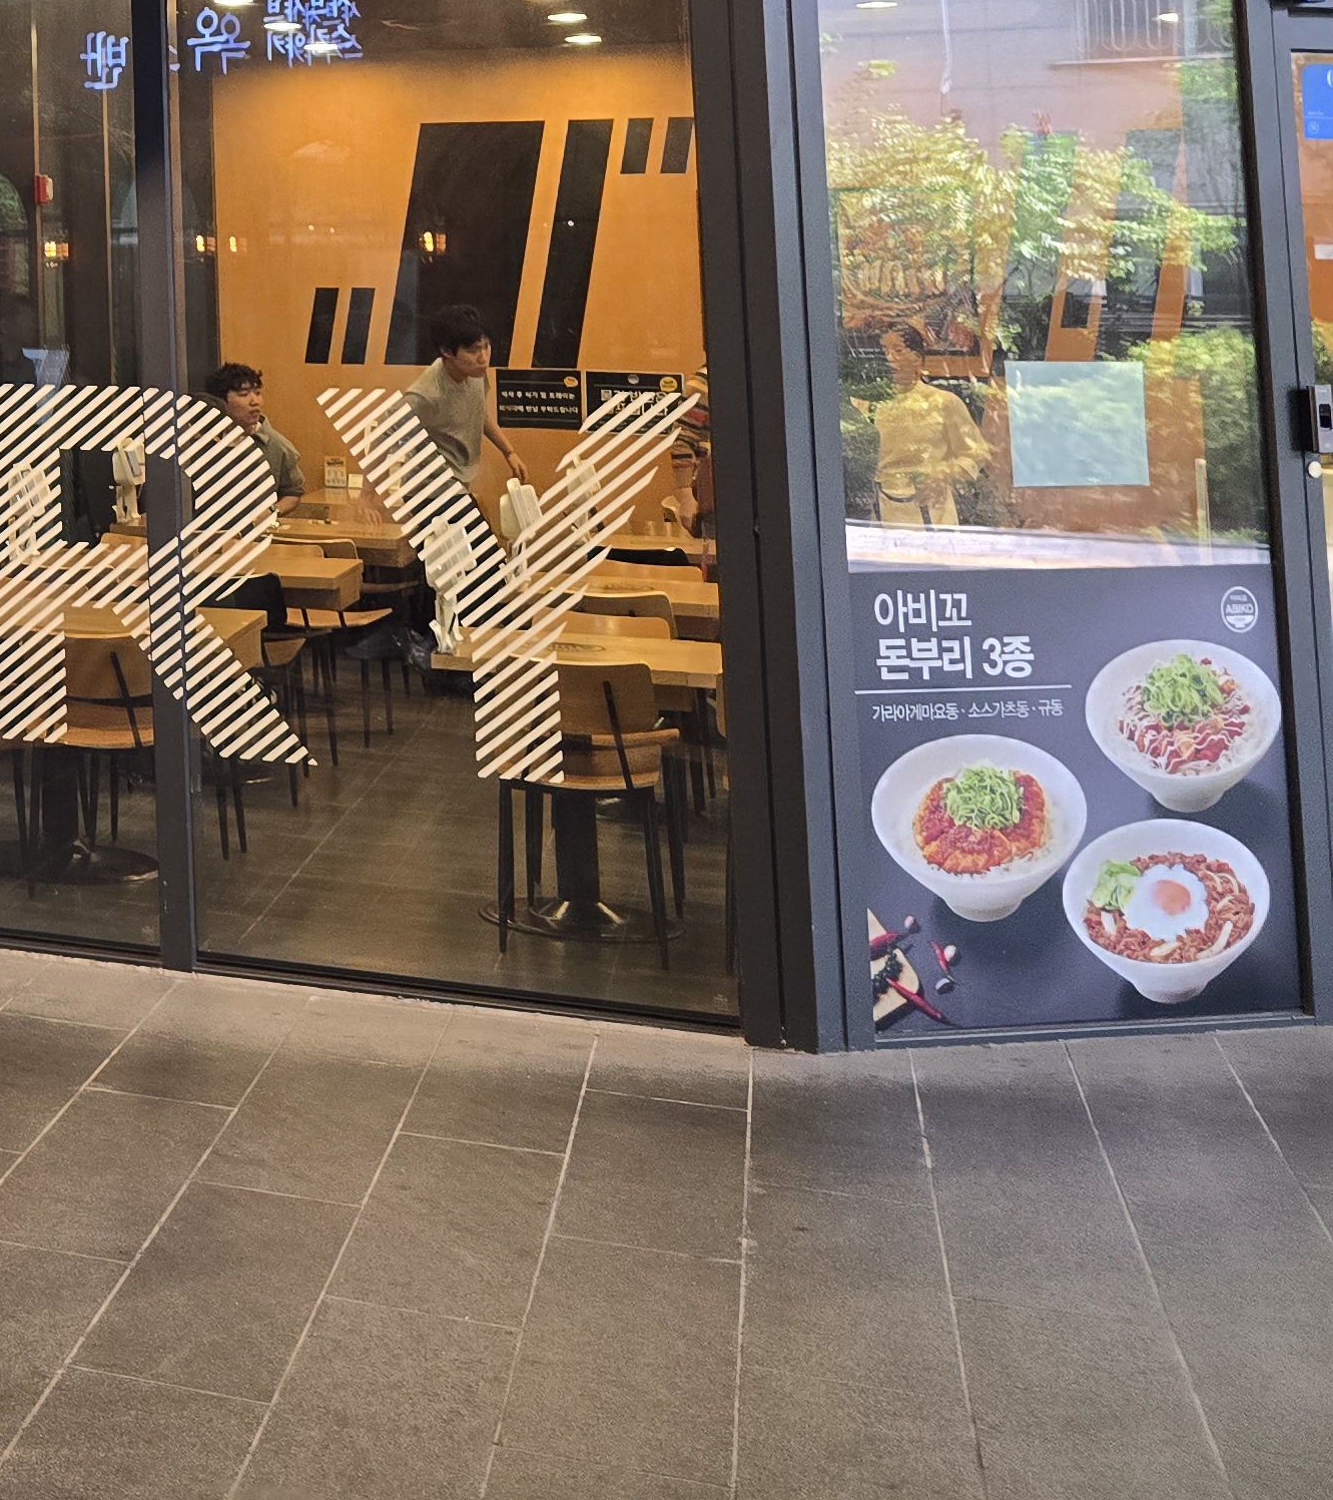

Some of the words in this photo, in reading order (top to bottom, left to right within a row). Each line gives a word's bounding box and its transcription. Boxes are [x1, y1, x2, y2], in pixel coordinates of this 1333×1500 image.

[874, 589, 973, 633] 아비꼬
[1225, 603, 1254, 614] ABIKO
[875, 635, 973, 680] 돈부리
[981, 635, 1035, 679] 3종
[871, 703, 960, 722] 가라아게마요동
[967, 700, 1031, 719] 소스가츠동
[1037, 698, 1064, 717] 규동
